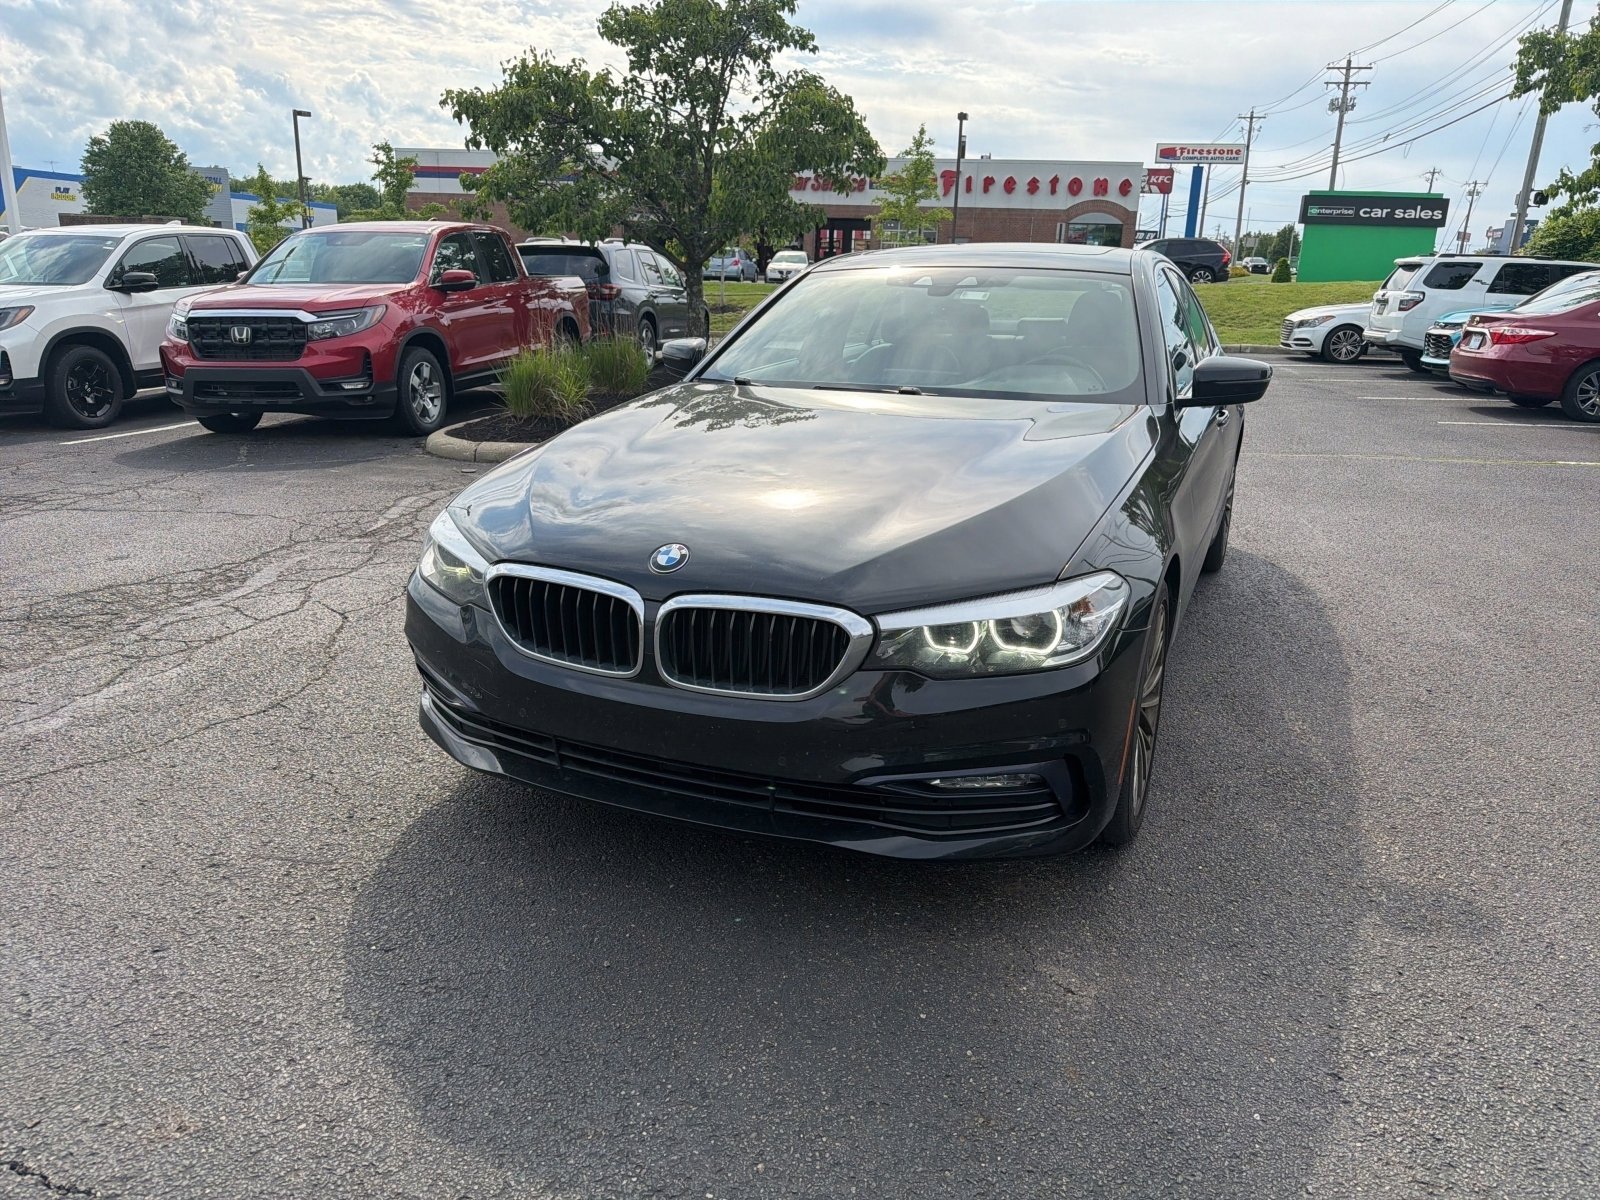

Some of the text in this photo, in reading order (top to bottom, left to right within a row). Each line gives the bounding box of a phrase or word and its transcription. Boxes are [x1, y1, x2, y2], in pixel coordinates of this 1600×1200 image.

[1178, 147, 1242, 156] Firestone
[940, 169, 1133, 197] Firestone
[1149, 175, 1172, 184] KFC
[1309, 205, 1443, 220] enterprise car sales
